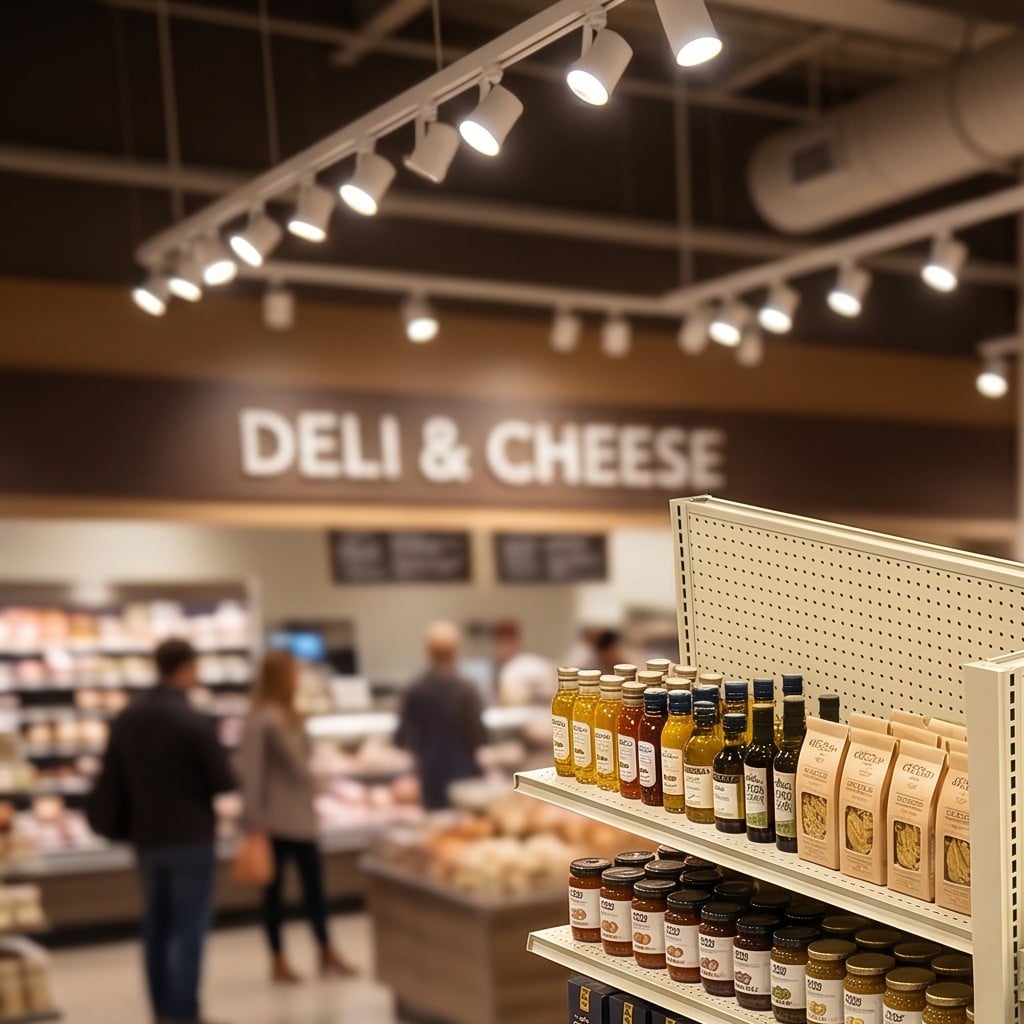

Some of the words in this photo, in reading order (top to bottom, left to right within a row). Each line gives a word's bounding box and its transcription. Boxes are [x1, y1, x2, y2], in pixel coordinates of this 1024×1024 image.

[240, 409, 401, 480] DELI
[419, 416, 471, 482] &
[486, 420, 725, 488] CHEESE
